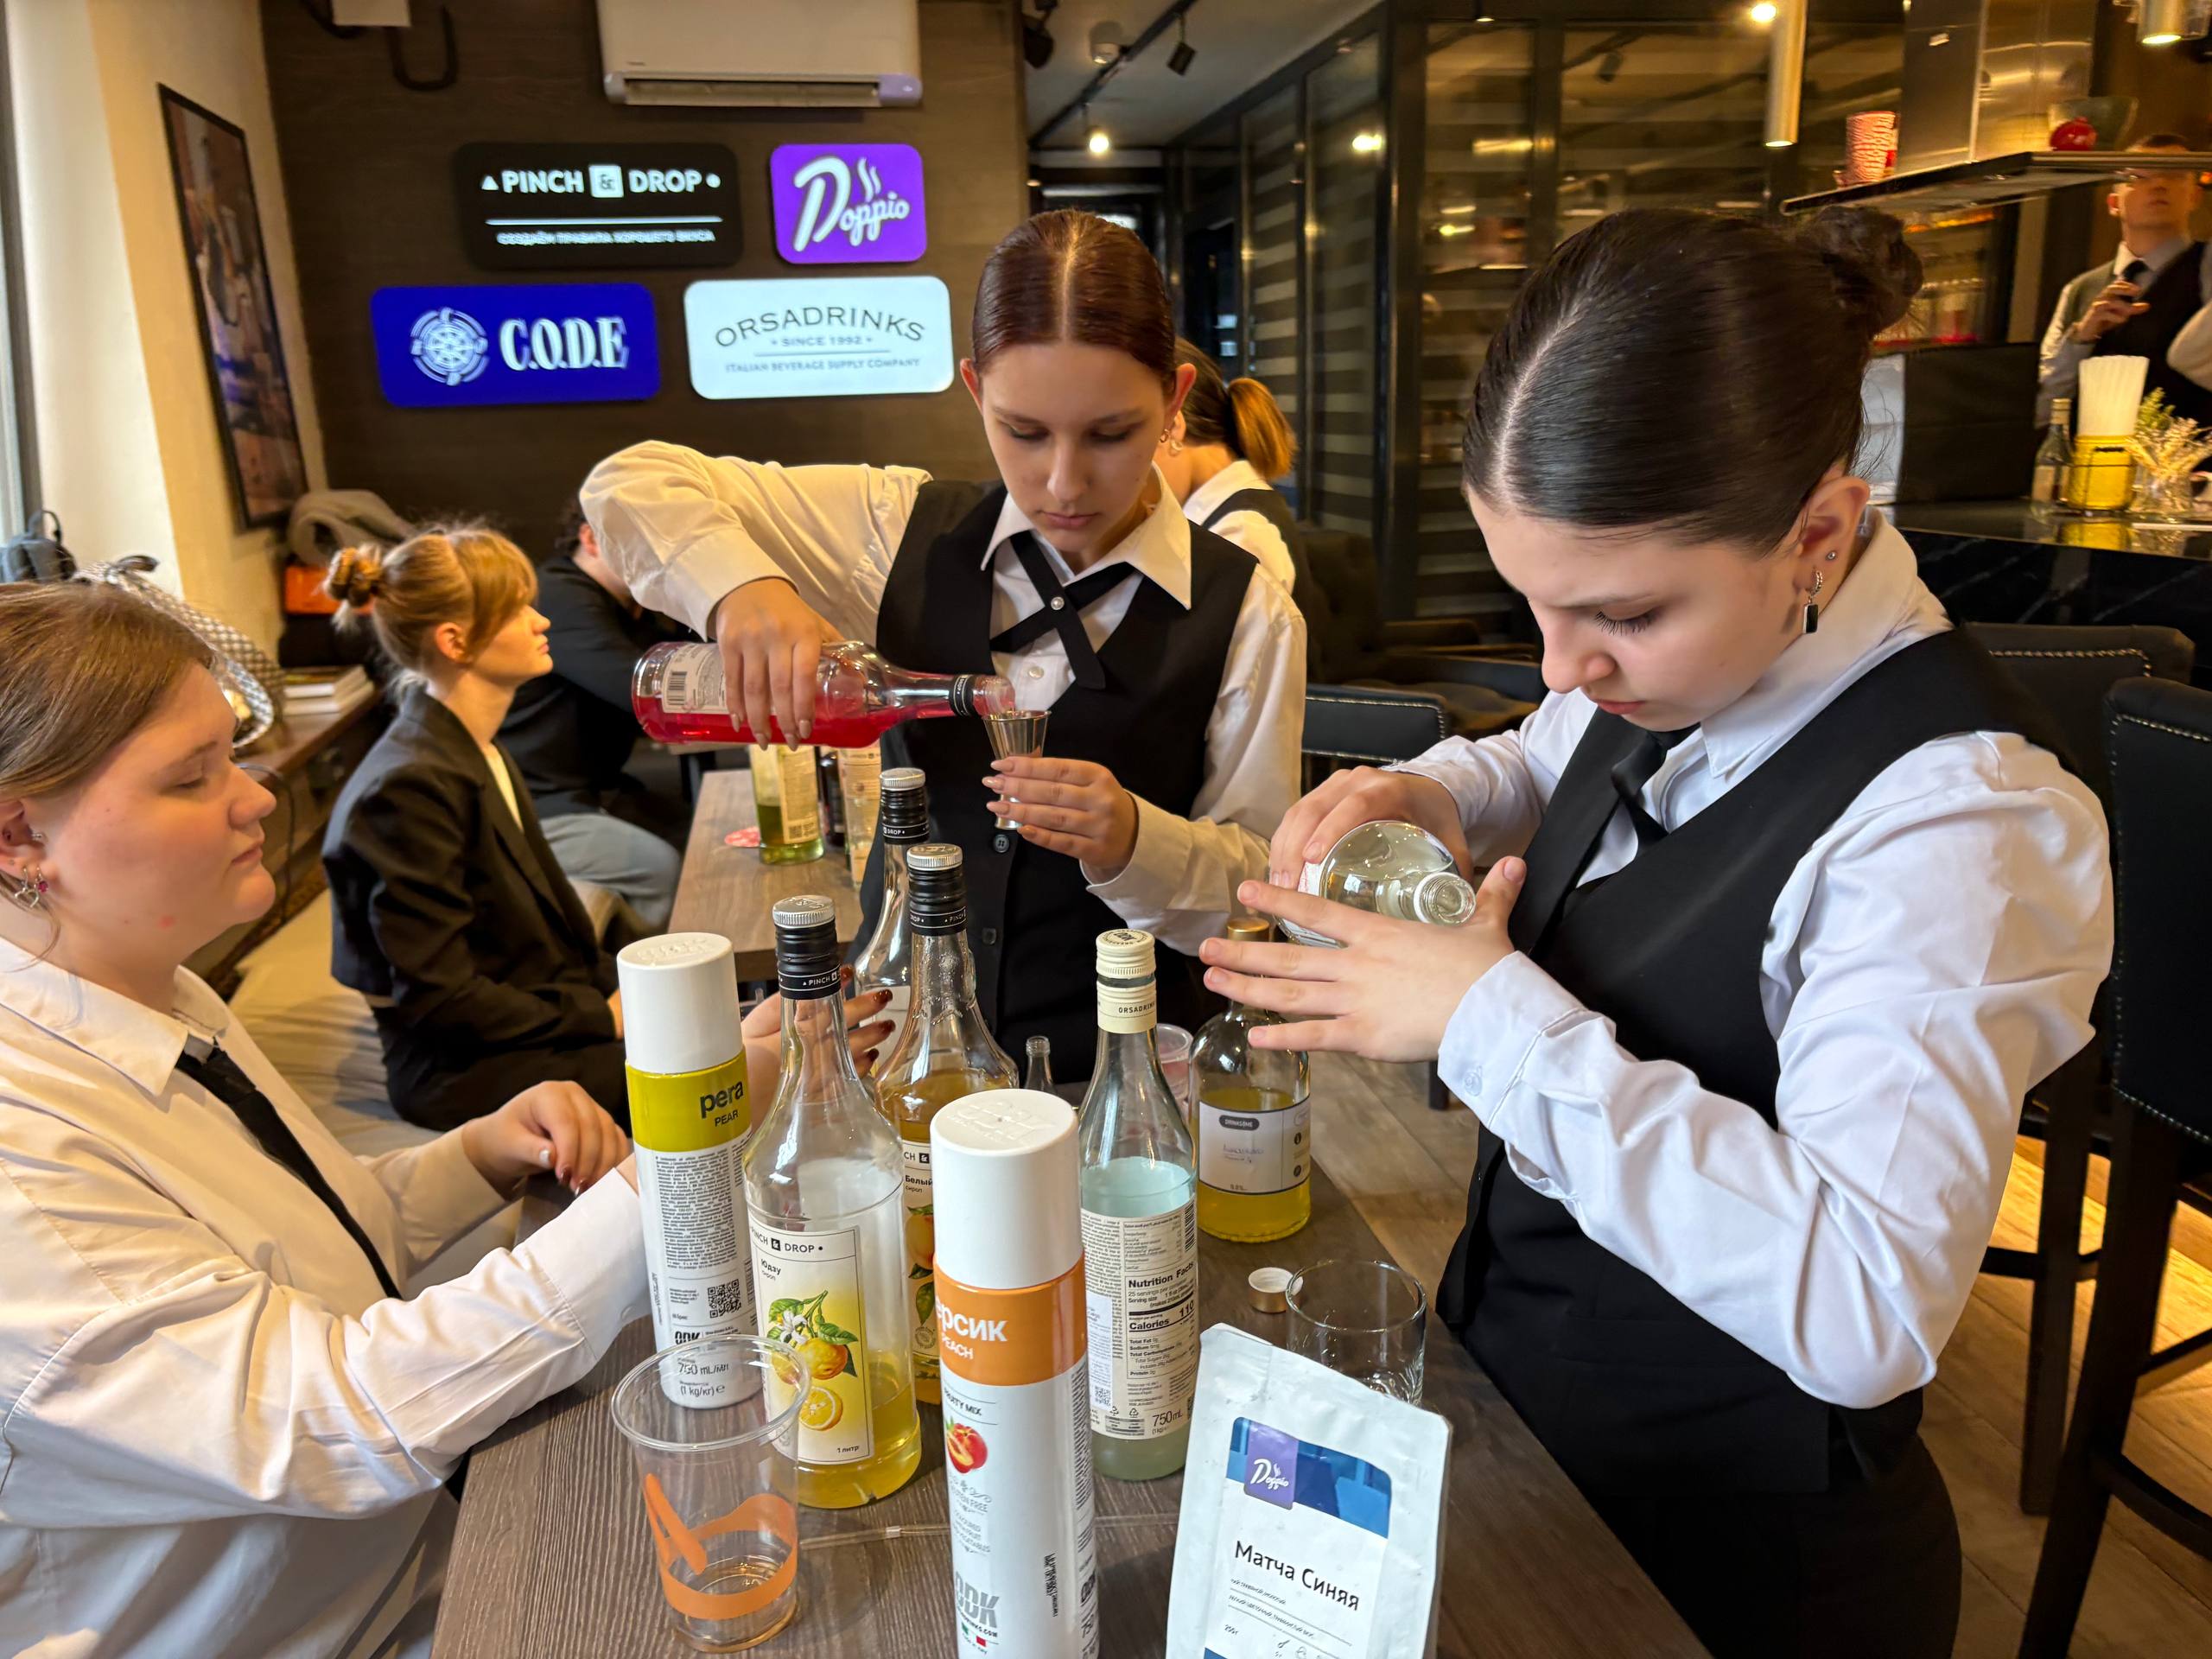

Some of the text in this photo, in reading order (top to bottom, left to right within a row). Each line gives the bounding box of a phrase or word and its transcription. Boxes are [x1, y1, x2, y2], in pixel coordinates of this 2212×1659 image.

[501, 168, 585, 194] PINCH
[628, 168, 702, 194] DROP
[793, 156, 911, 252] Doppio
[715, 306, 925, 347] ORSADRINKS
[781, 335, 863, 347] SINCE 1992
[725, 357, 921, 373] ITALIAN BEVERAGE SUPPLY COMPANY
[809, 976, 830, 987] PINCH
[700, 1080, 744, 1120] pera
[715, 1109, 739, 1128] PEAR
[785, 1243, 815, 1254] DROP
[1128, 1274, 1173, 1288] Nutrition
[1179, 1300, 1195, 1318] 110
[1128, 1319, 1170, 1331] Calories
[1249, 1458, 1289, 1491] Doppio
[1235, 1540, 1296, 1581] Матча
[1301, 1567, 1360, 1611] Синяя
